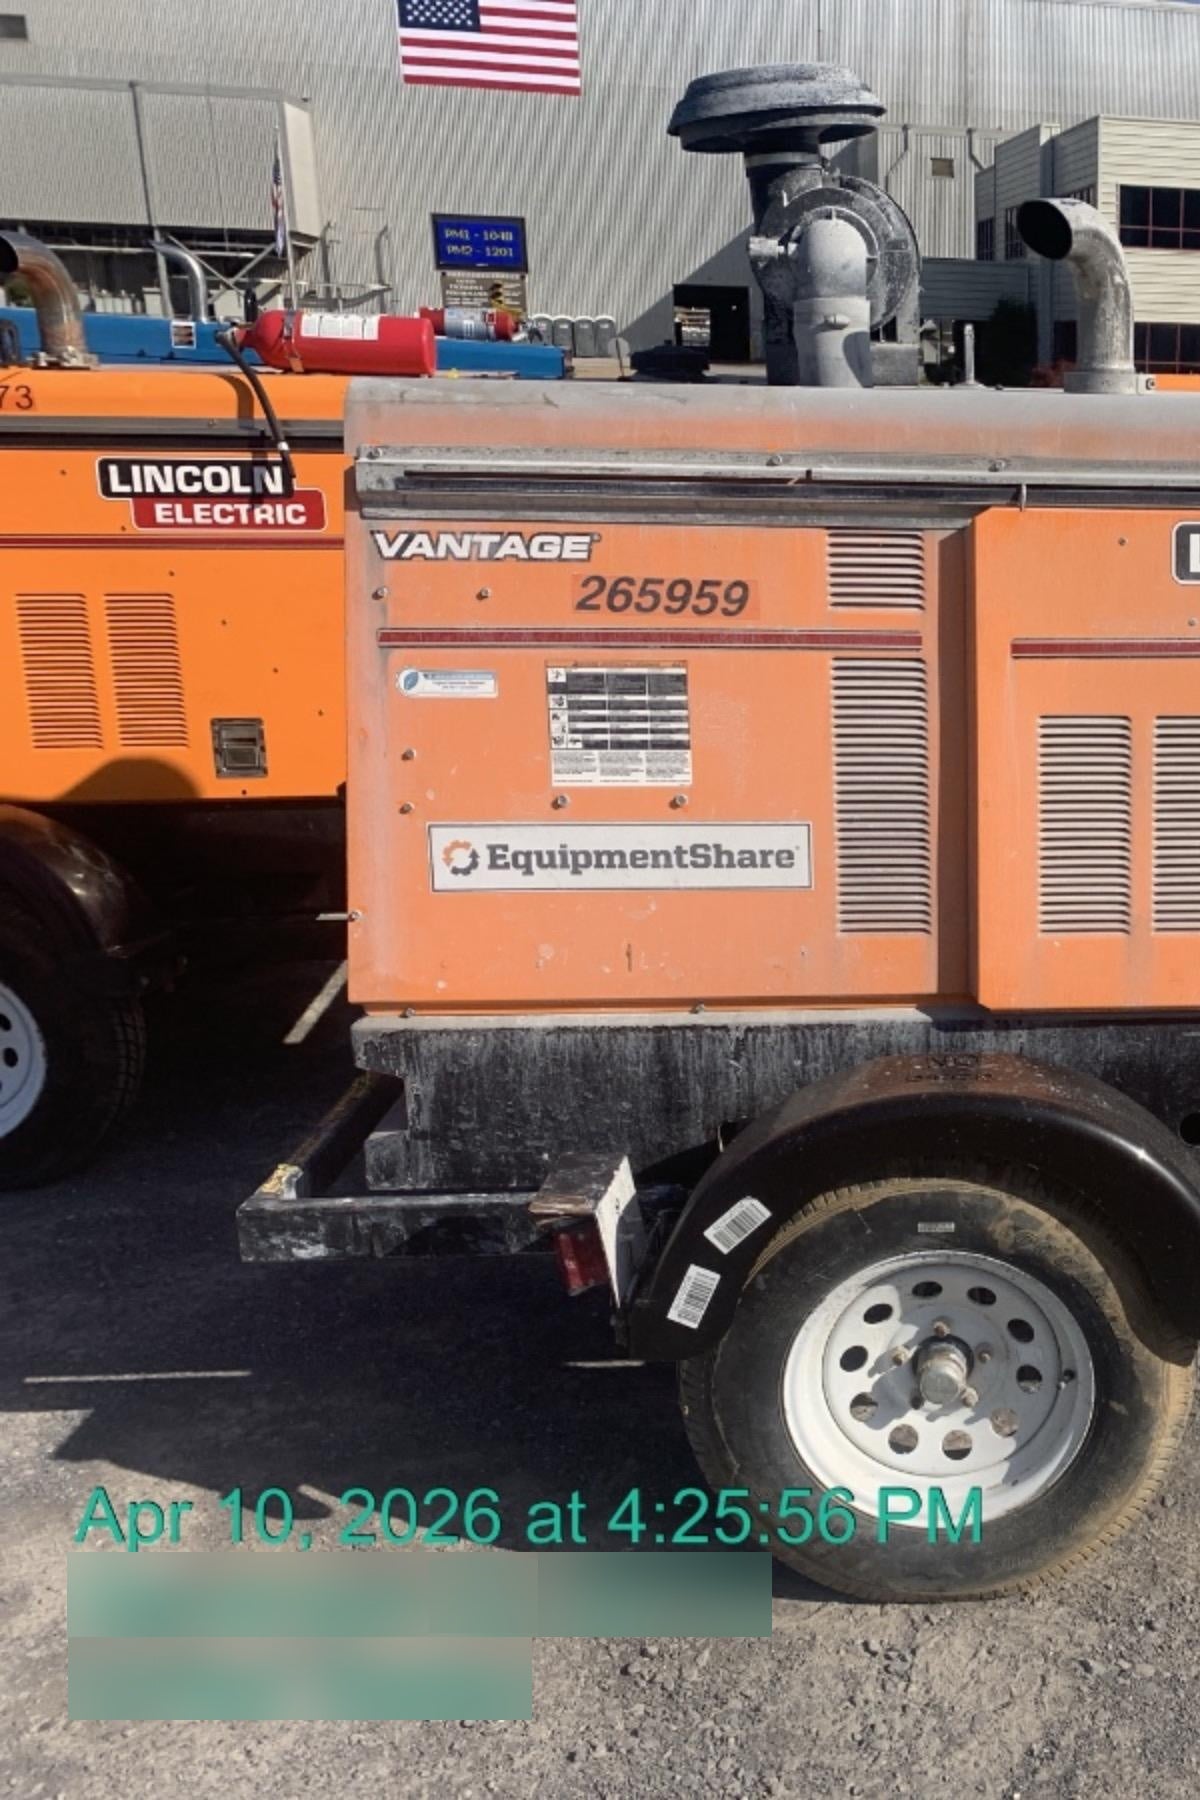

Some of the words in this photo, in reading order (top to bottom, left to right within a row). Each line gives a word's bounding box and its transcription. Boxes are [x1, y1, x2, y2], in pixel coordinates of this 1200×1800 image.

[108, 464, 283, 494] LINCOLN
[154, 502, 307, 525] ELECTRIC
[373, 532, 592, 561] VANTAGE
[575, 575, 750, 618] 265959
[487, 843, 795, 876] EquipmentShare
